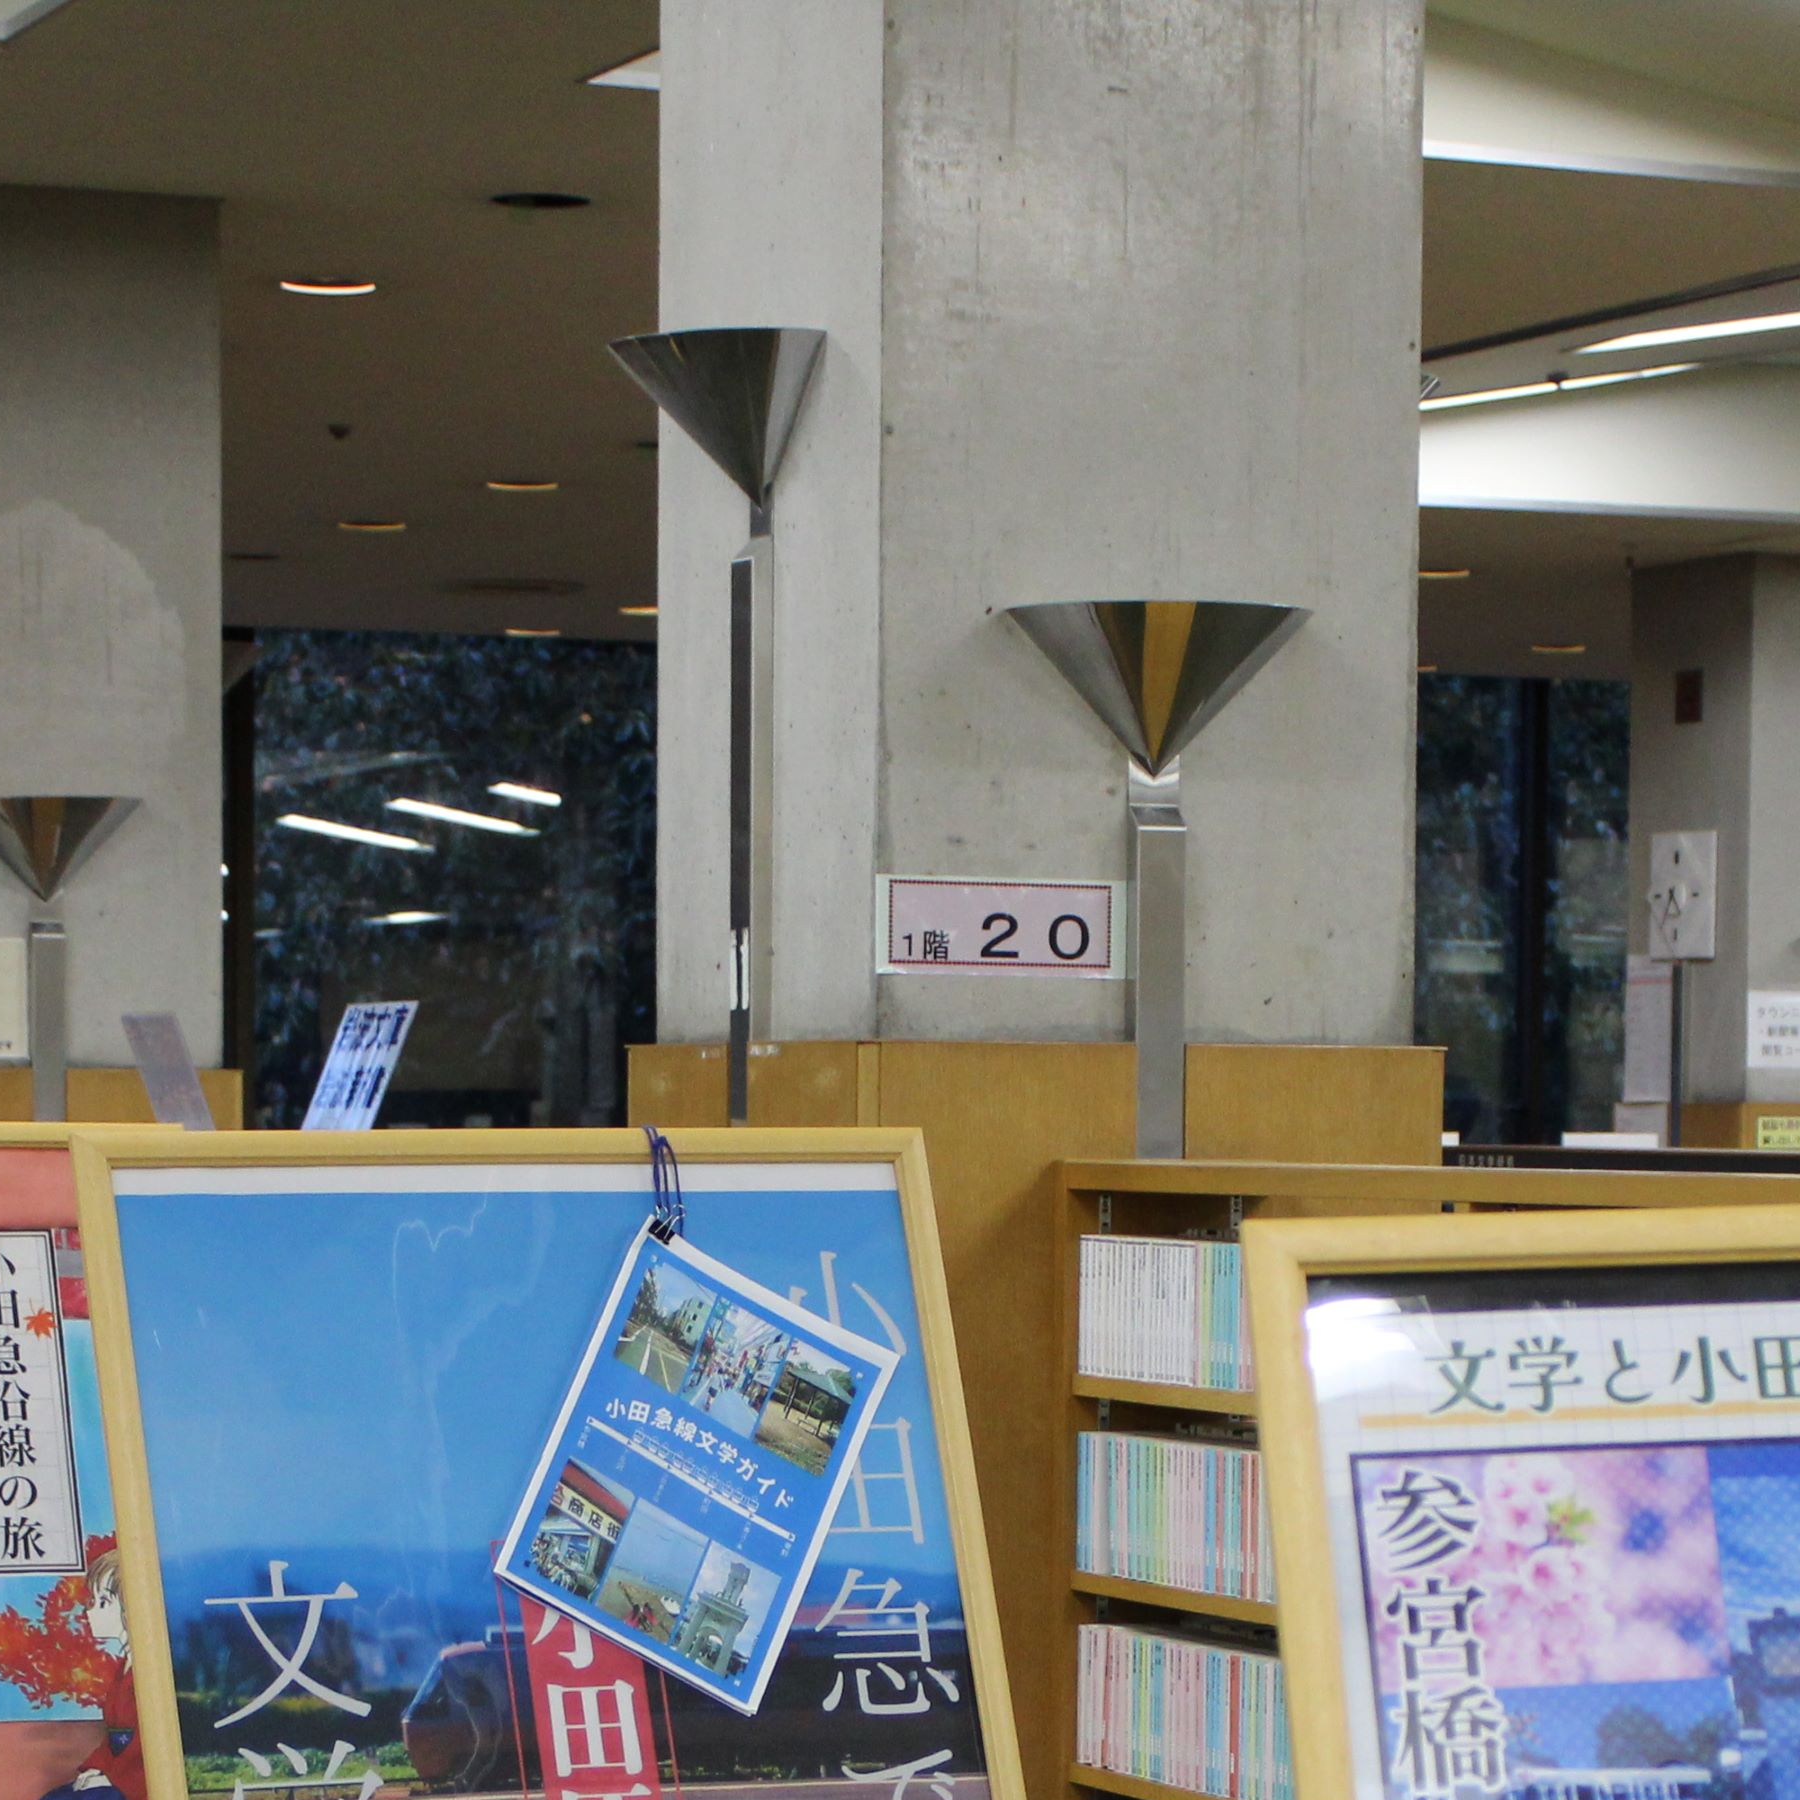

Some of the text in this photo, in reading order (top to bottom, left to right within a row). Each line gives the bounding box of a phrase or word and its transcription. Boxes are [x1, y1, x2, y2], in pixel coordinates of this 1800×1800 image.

[603, 1396, 797, 1511] 小田急線文学ガイド
